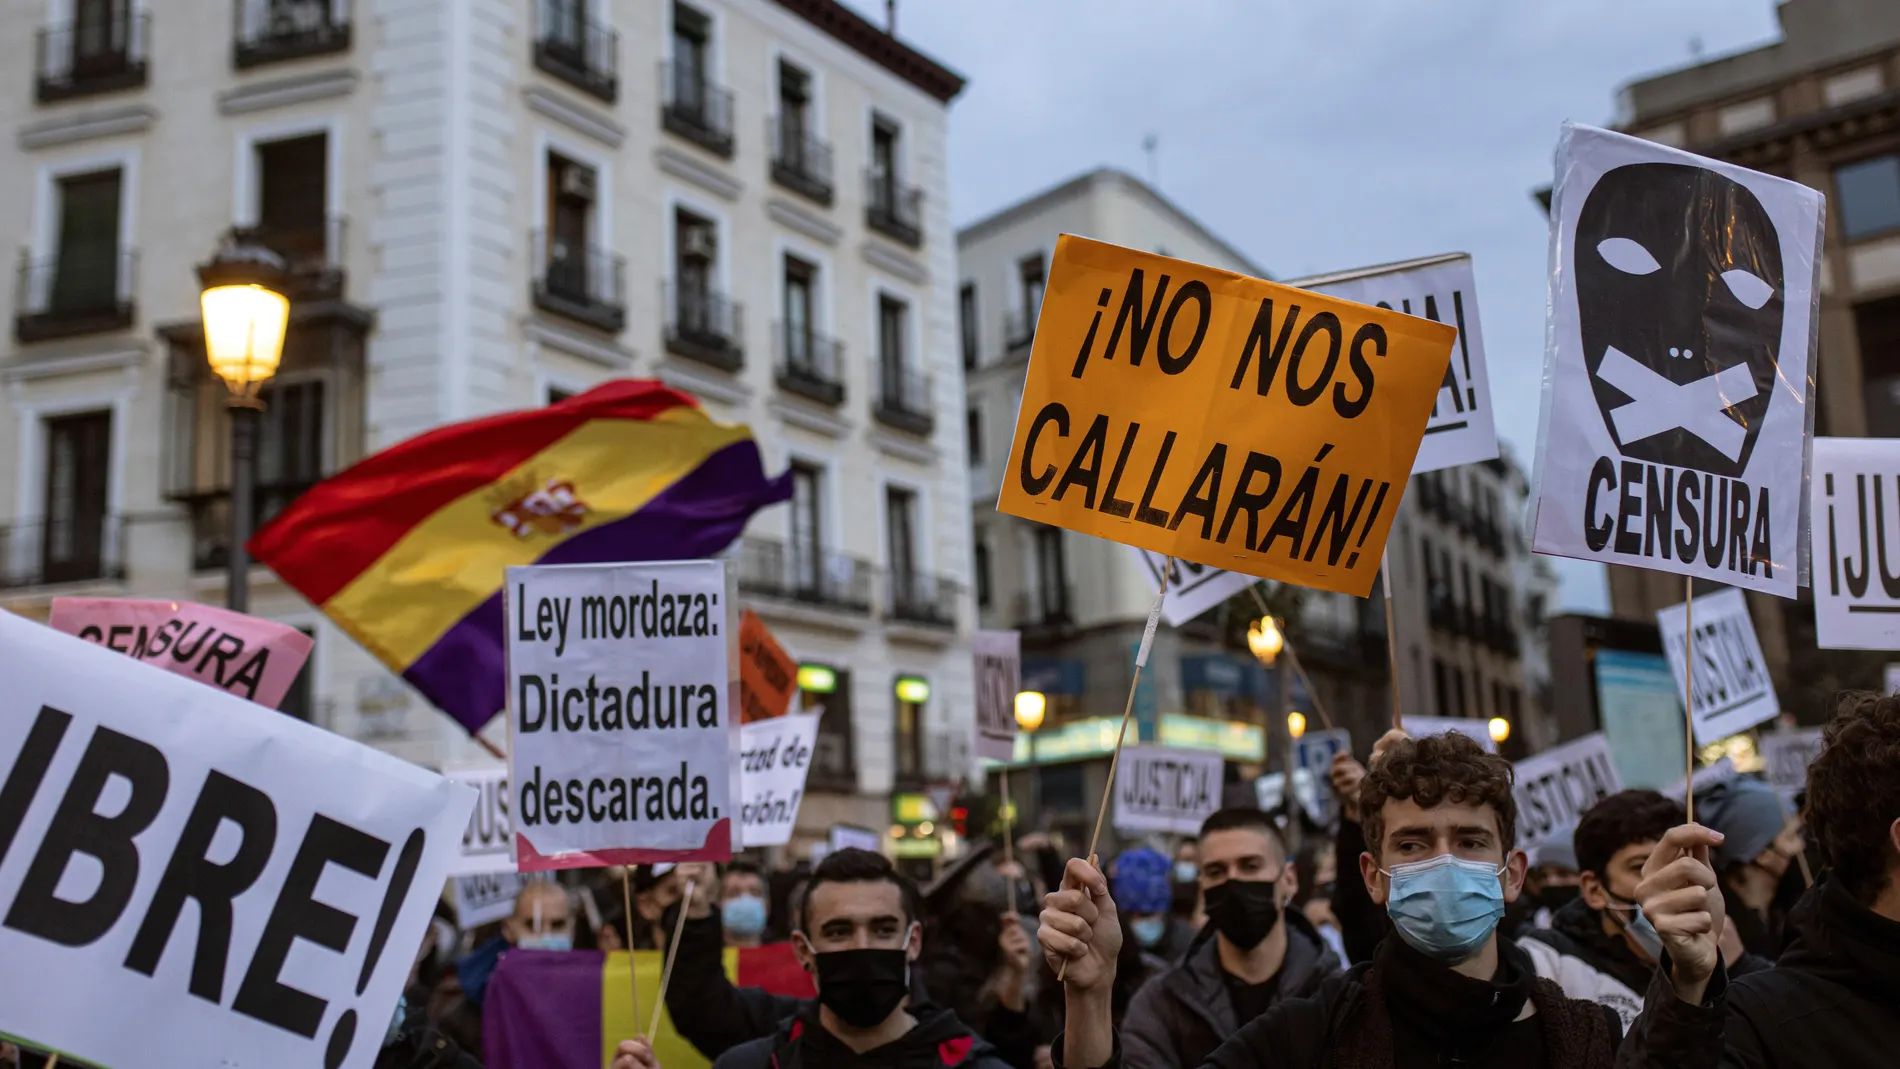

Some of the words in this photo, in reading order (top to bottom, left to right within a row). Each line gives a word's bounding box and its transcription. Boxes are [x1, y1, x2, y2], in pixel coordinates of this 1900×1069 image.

[1071, 268, 1212, 379] ¡NO
[1230, 297, 1388, 419] NOS
[1020, 402, 1391, 570] CALLARÁN!
[1584, 455, 1773, 579] CENSURA
[518, 583, 572, 657] Ley
[581, 579, 718, 640] mordaza:
[519, 671, 718, 733] Dictadura
[782, 735, 808, 769] de
[520, 761, 719, 826] descarada.
